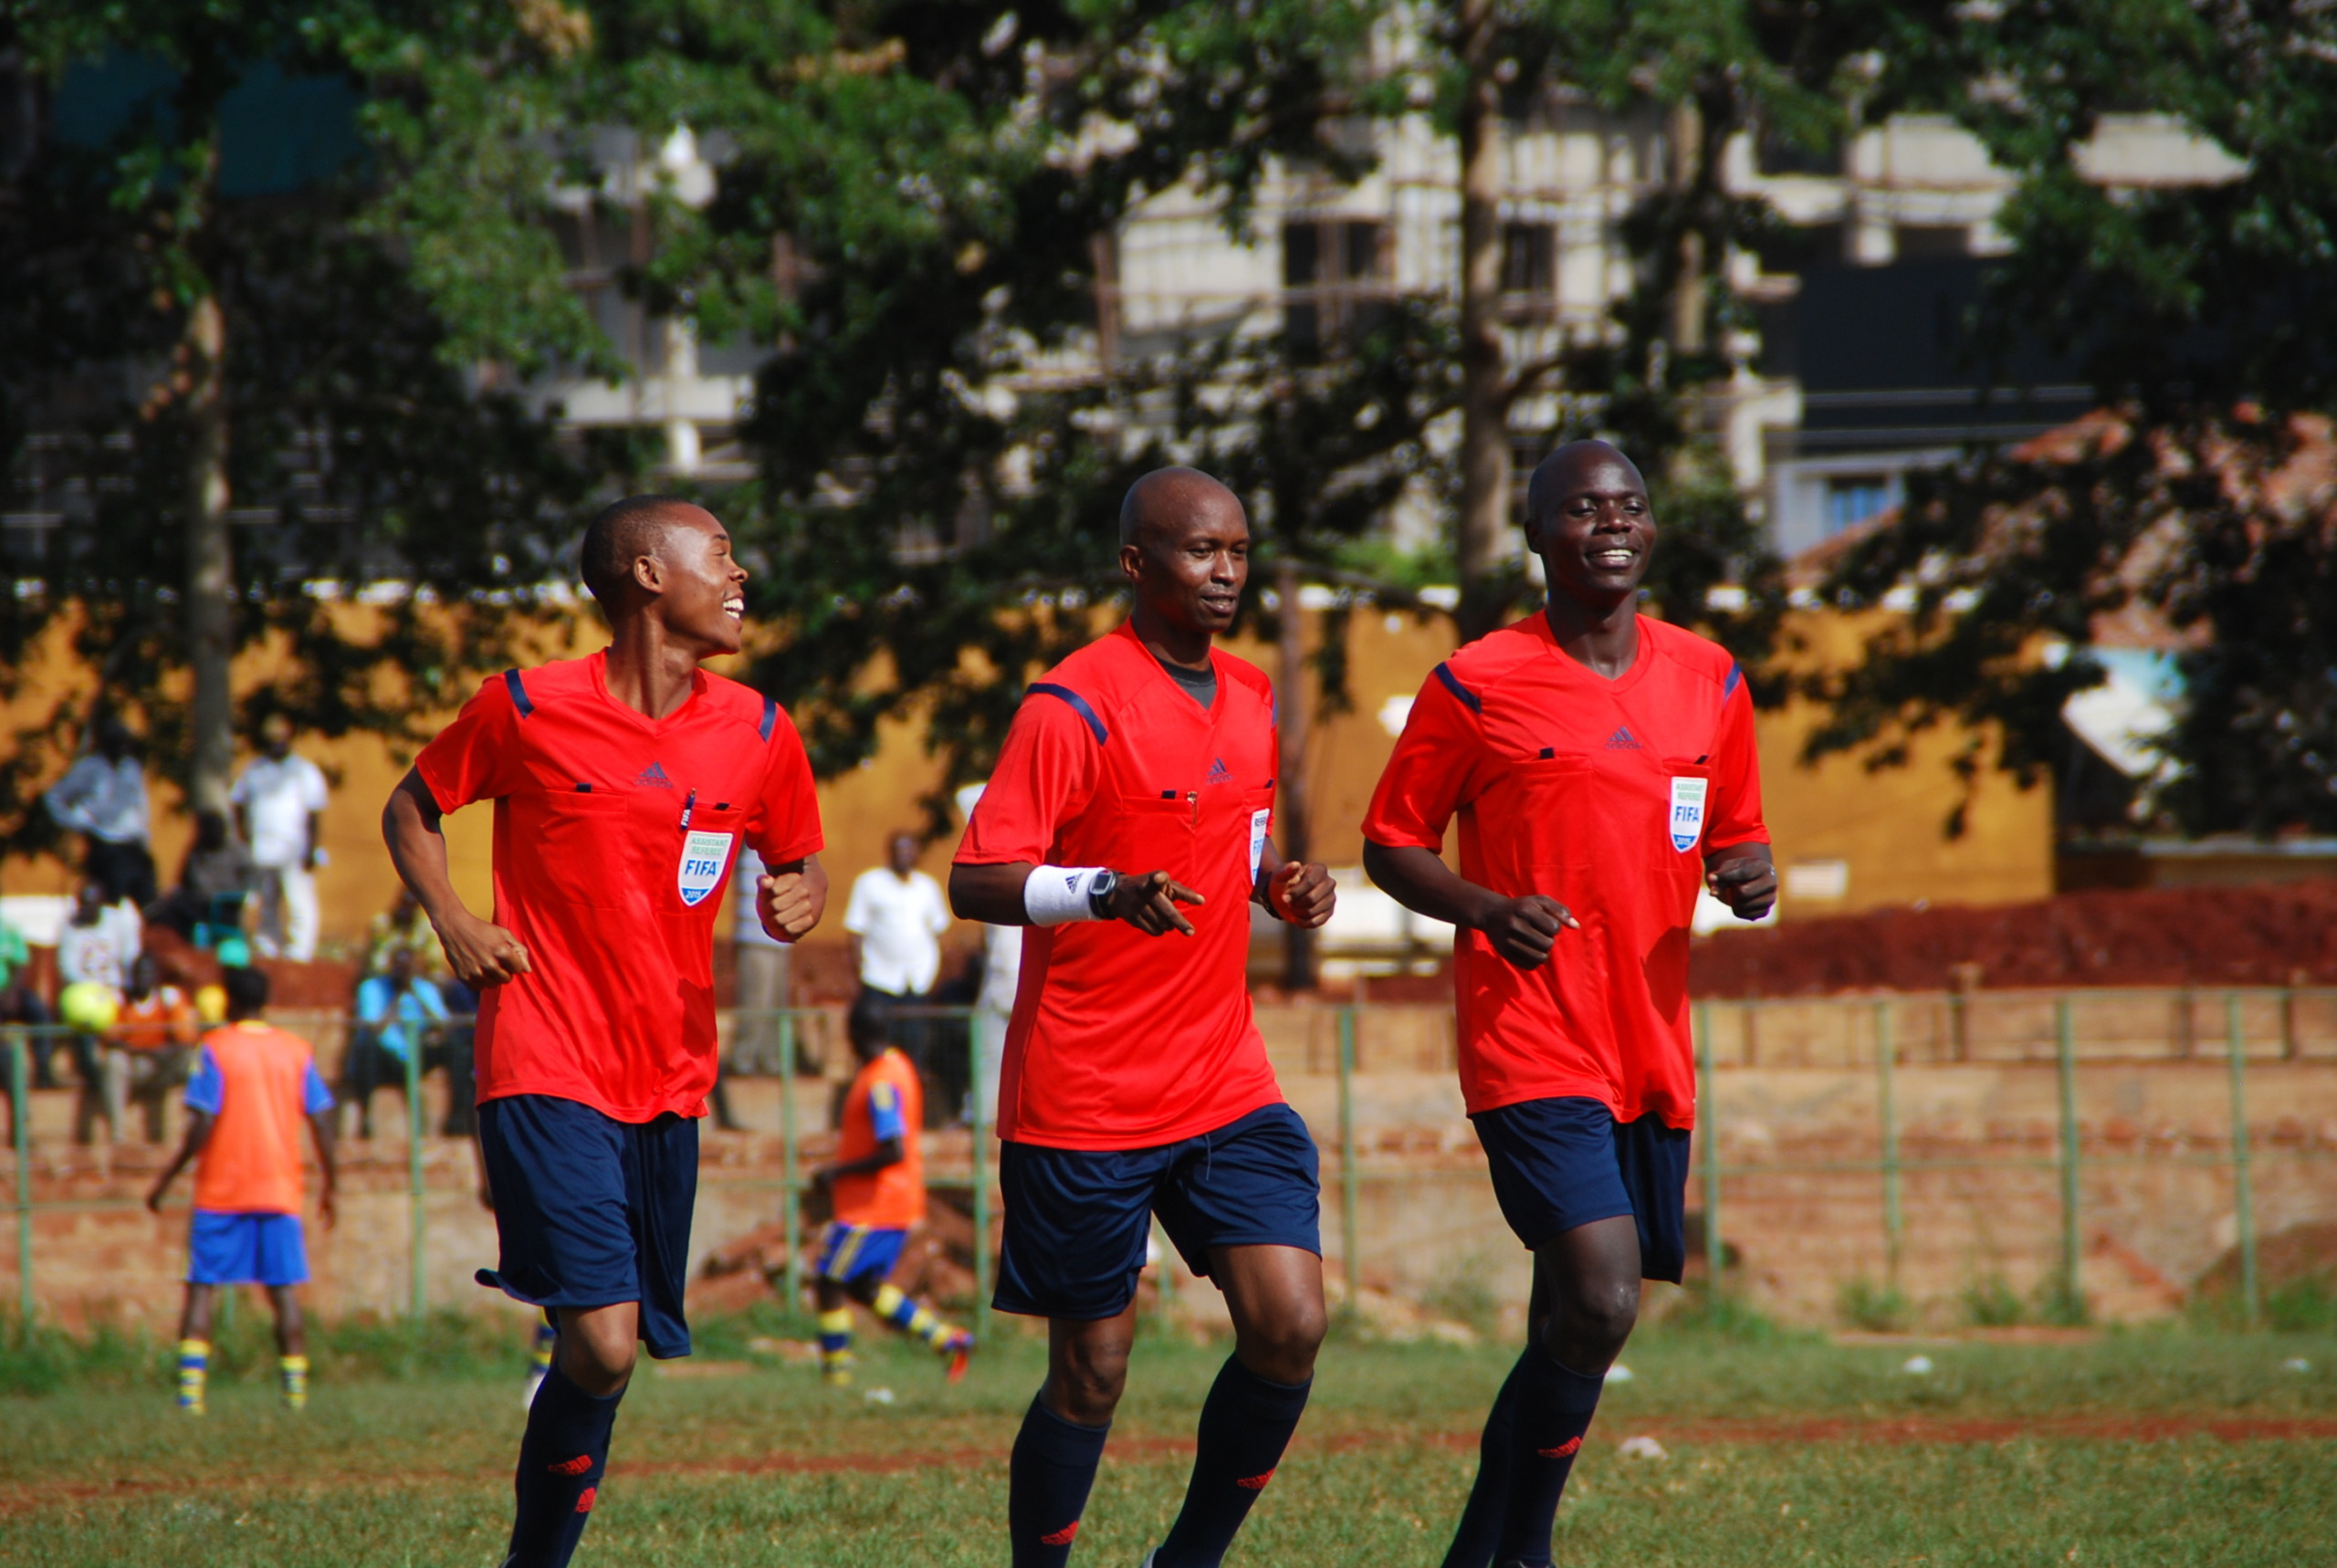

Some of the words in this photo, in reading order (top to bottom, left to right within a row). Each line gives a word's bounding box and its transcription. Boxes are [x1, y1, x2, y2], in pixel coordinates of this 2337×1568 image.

[1674, 806, 1700, 822] FIFA
[692, 837, 729, 847] ASSISTANT
[691, 845, 722, 855] REFEREE
[684, 860, 718, 875] FIFA
[685, 890, 703, 899] 2015
